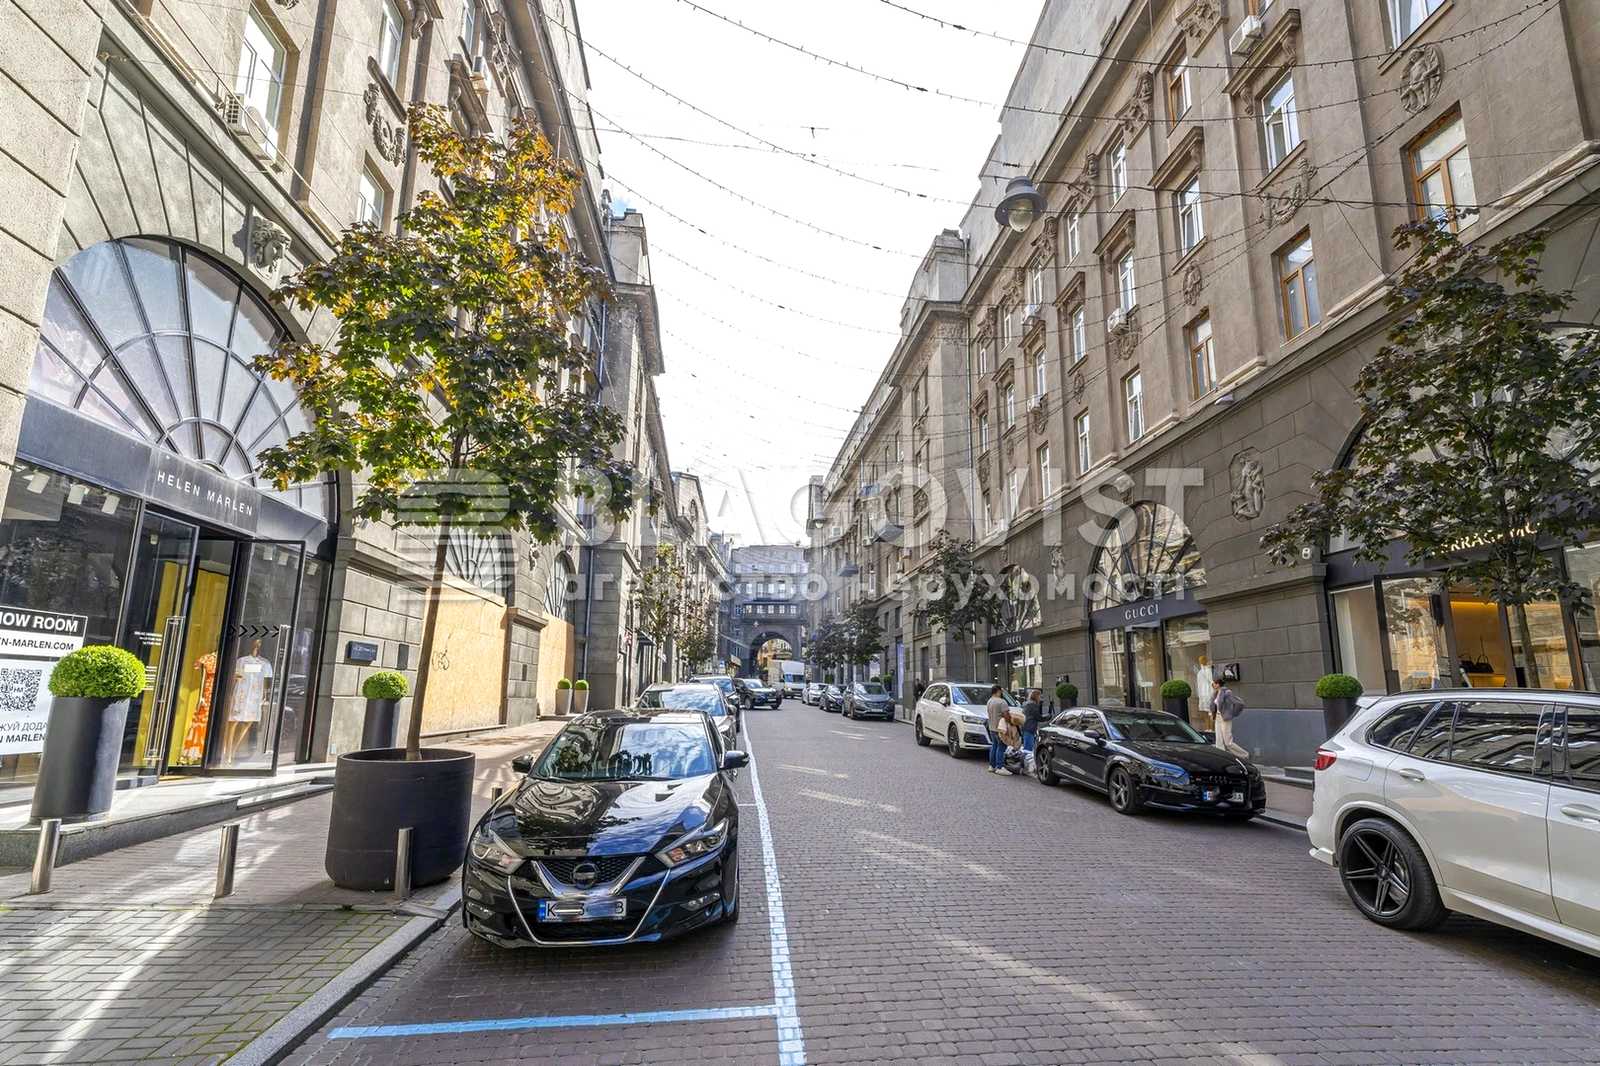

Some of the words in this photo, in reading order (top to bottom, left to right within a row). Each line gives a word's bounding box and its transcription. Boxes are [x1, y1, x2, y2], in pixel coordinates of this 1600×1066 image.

[157, 471, 200, 497] HELEN
[206, 490, 253, 516] MARLEN
[1302, 547, 1311, 560] 8
[1125, 603, 1159, 620] GUCCI
[0, 611, 31, 628] OW
[32, 615, 79, 633] ROOM
[0, 637, 74, 651] N-MARLEN.COM
